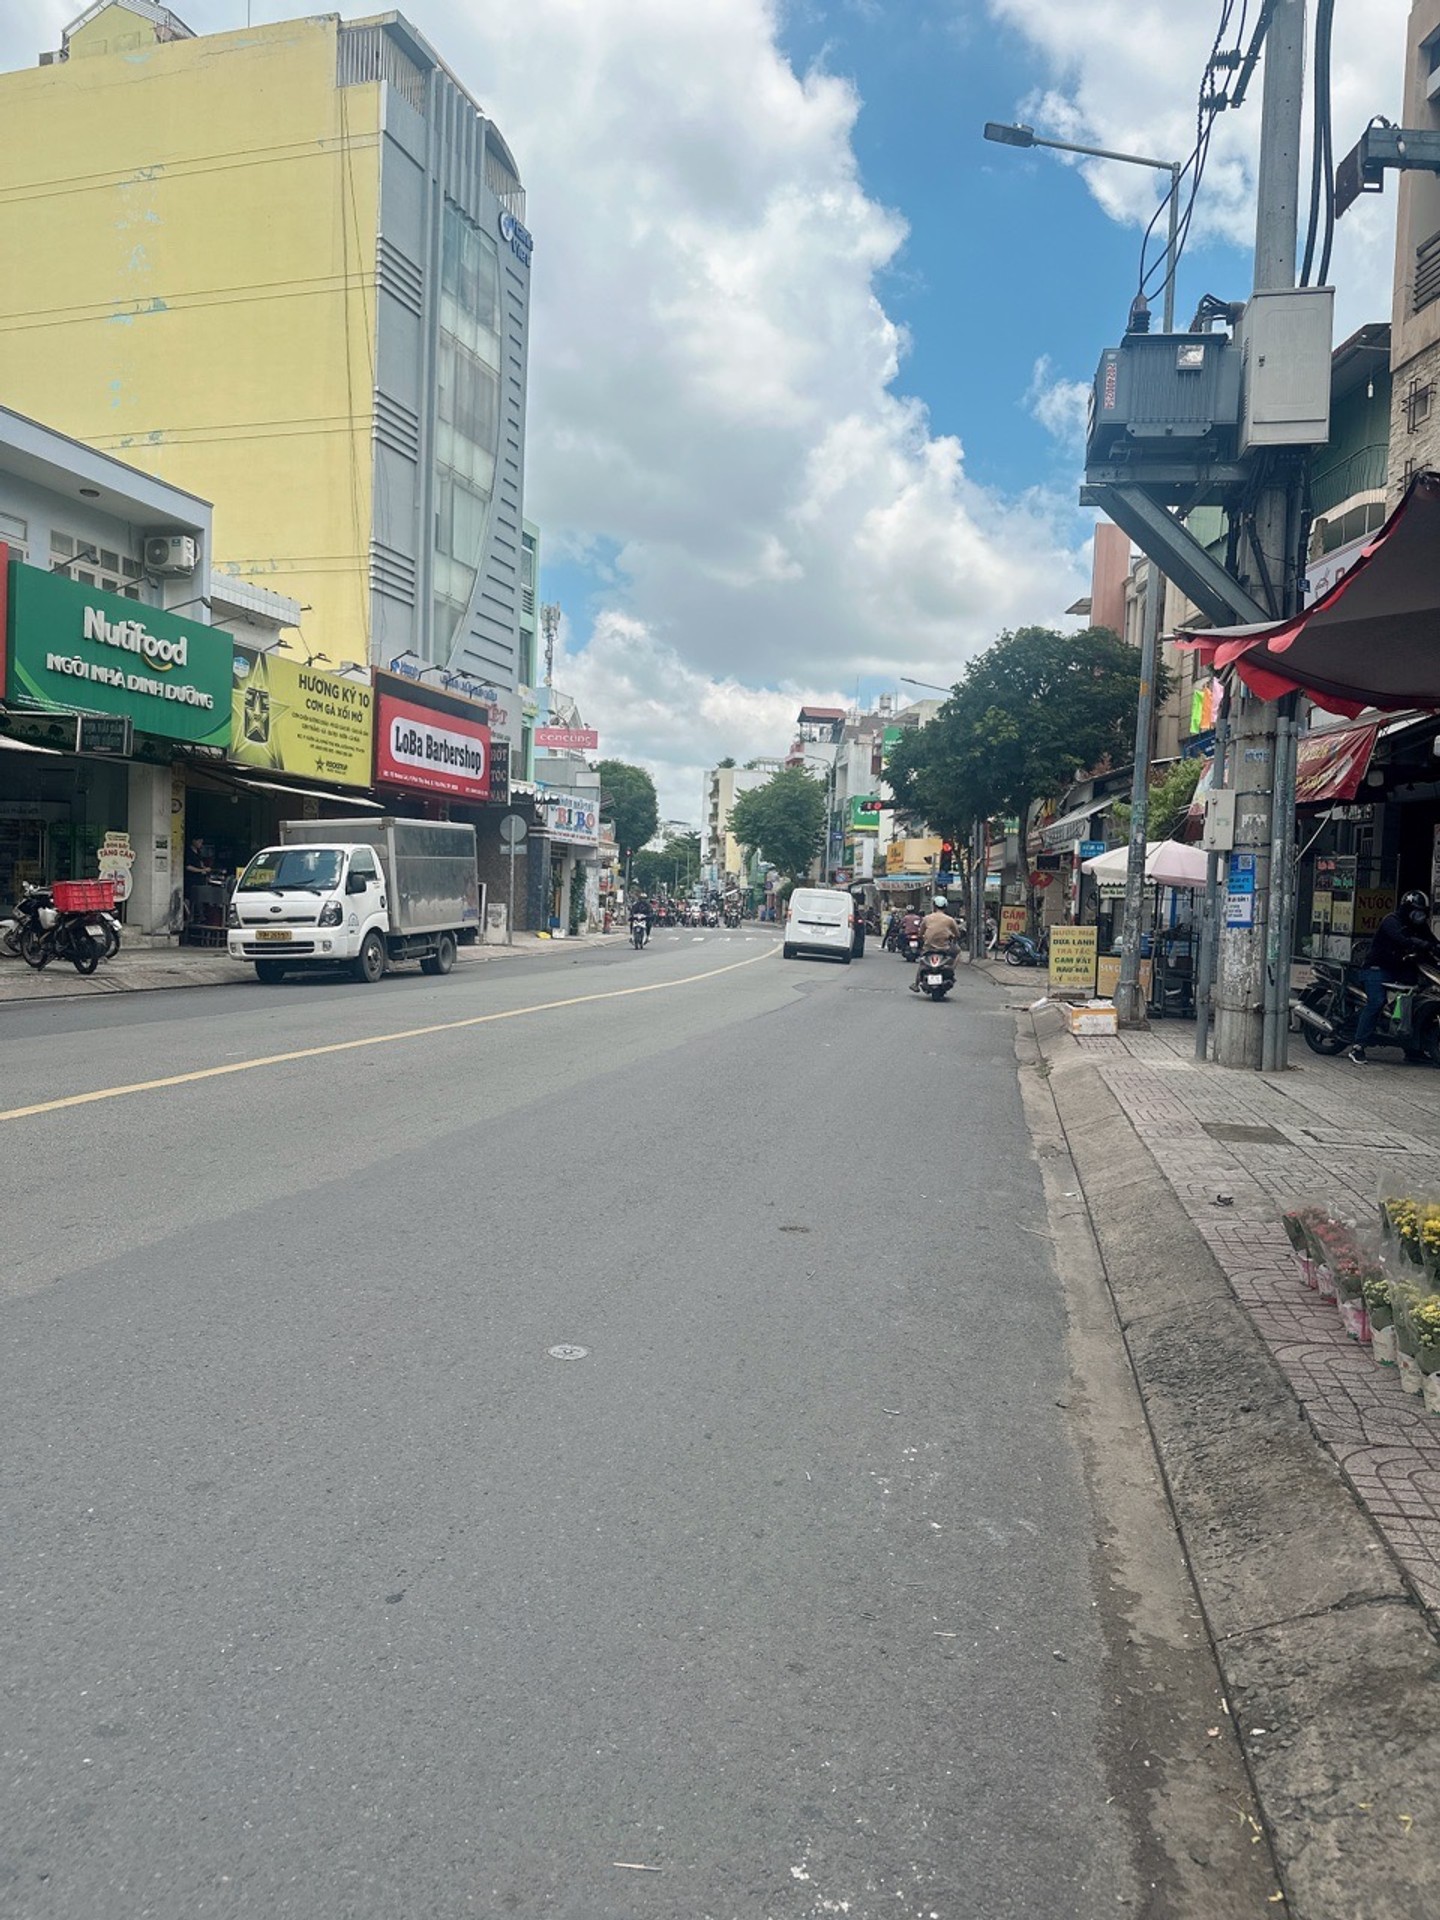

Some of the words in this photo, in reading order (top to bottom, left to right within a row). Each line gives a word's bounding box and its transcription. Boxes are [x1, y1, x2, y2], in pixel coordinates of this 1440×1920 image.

[83, 606, 188, 667] Nutifood
[46, 653, 90, 678] NGÔI
[91, 665, 126, 689] NHÀ
[127, 674, 165, 698] DINH
[165, 684, 214, 710] DƯỠNG
[298, 673, 340, 699] HƯƠNG
[341, 686, 357, 704] KÝ
[359, 692, 370, 708] 10
[305, 698, 324, 713] CƠM
[324, 702, 336, 716] GÀ
[395, 725, 423, 758] LoBa
[425, 733, 482, 775] Barbershop
[1358, 894, 1393, 910] NƯỚC
